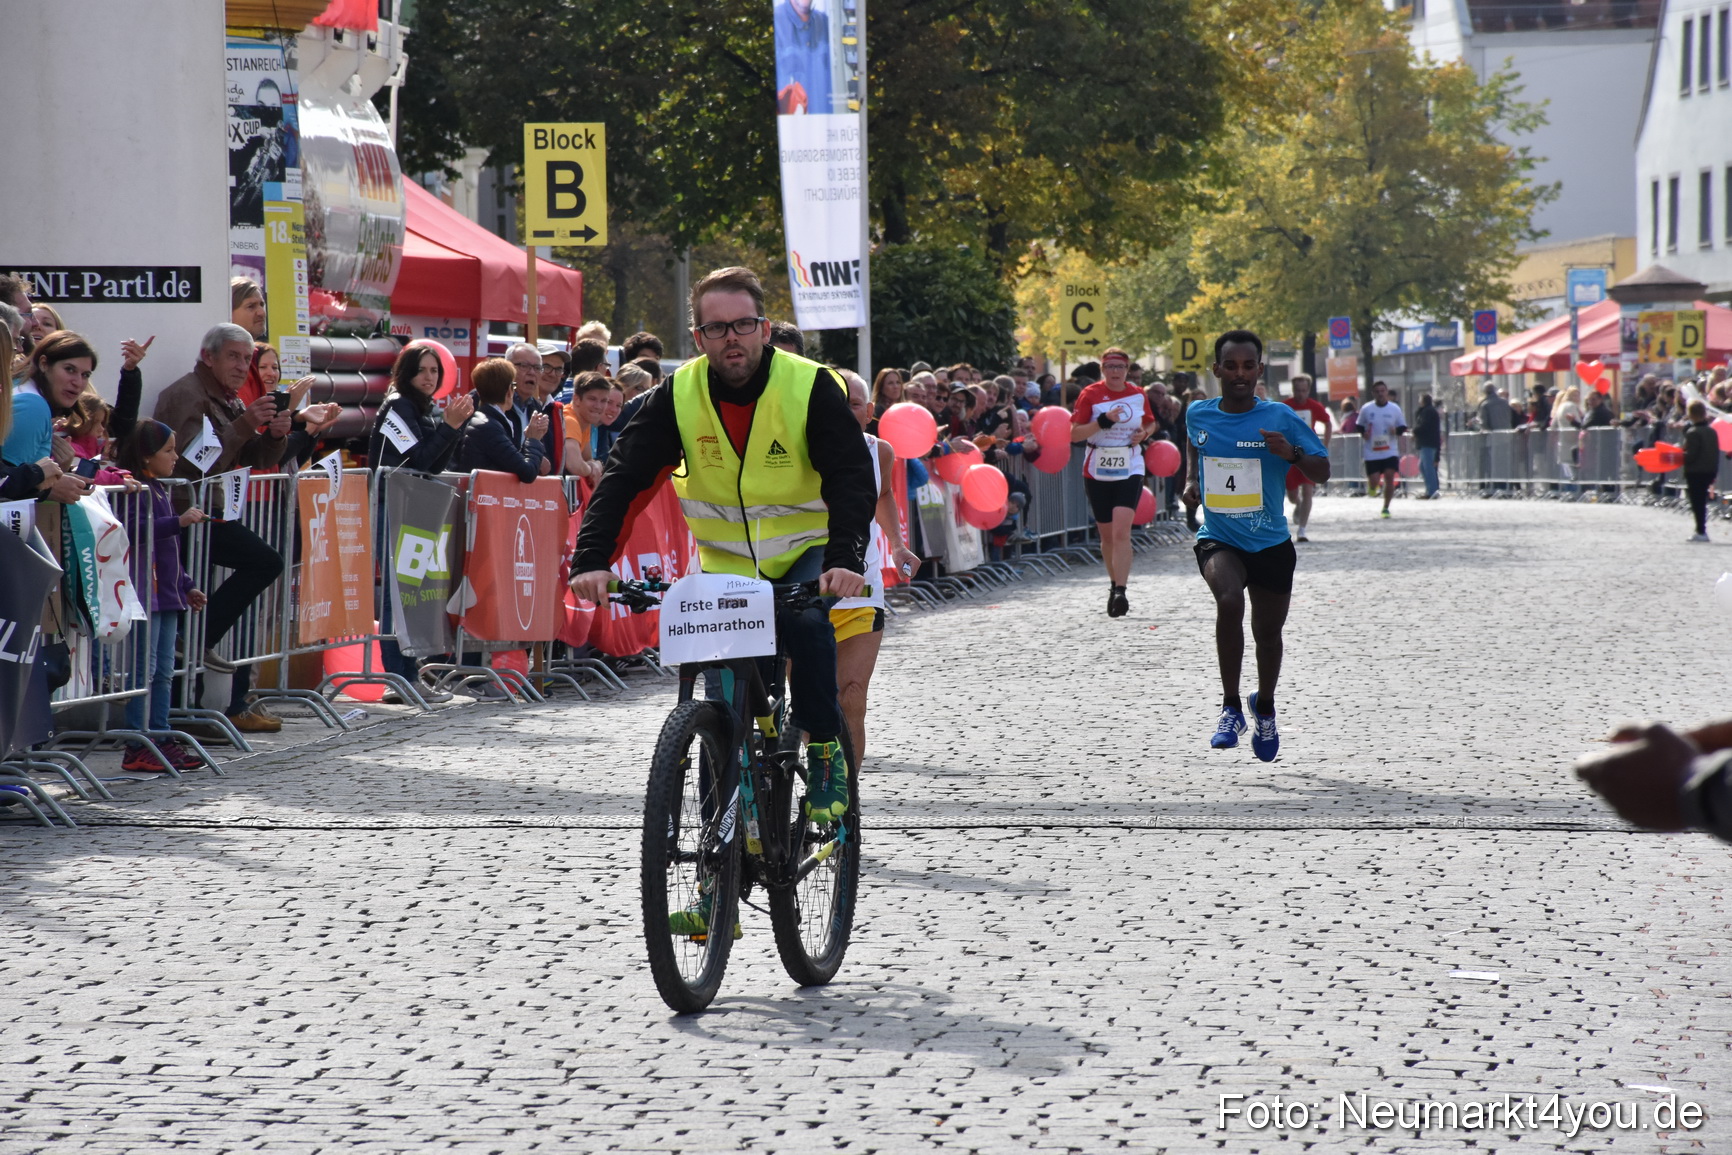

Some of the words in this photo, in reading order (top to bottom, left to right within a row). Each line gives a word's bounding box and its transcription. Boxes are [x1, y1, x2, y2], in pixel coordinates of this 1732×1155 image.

[243, 120, 260, 135] CUP
[534, 128, 596, 150] Block
[546, 160, 587, 219] B
[1065, 285, 1100, 297] Block
[1071, 301, 1094, 335] C
[1677, 311, 1704, 321] Block
[1176, 325, 1202, 334] Block
[1682, 324, 1699, 349] D
[1332, 338, 1350, 346] TAXI
[1475, 334, 1496, 344] TAXI
[1181, 338, 1198, 361] D
[1100, 456, 1125, 467] 2473
[1225, 475, 1236, 492] 4
[680, 600, 713, 613] Erste
[668, 618, 765, 637] Halbmarathon
